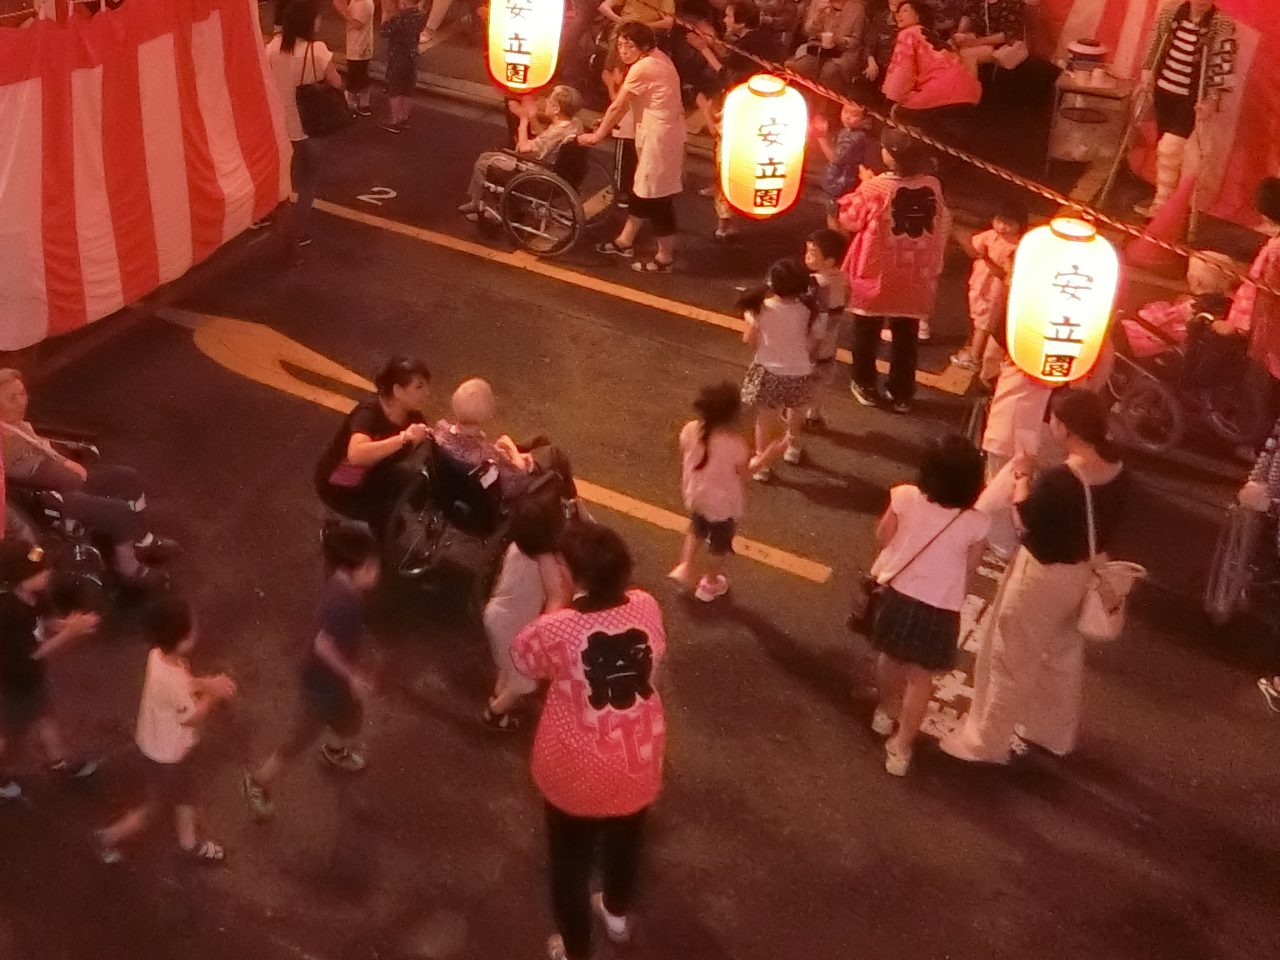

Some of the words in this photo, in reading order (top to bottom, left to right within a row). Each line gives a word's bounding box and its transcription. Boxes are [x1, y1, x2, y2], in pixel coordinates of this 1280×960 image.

[356, 186, 398, 206] 2
[754, 117, 788, 208] 安立園
[1041, 265, 1094, 377] 安立園
